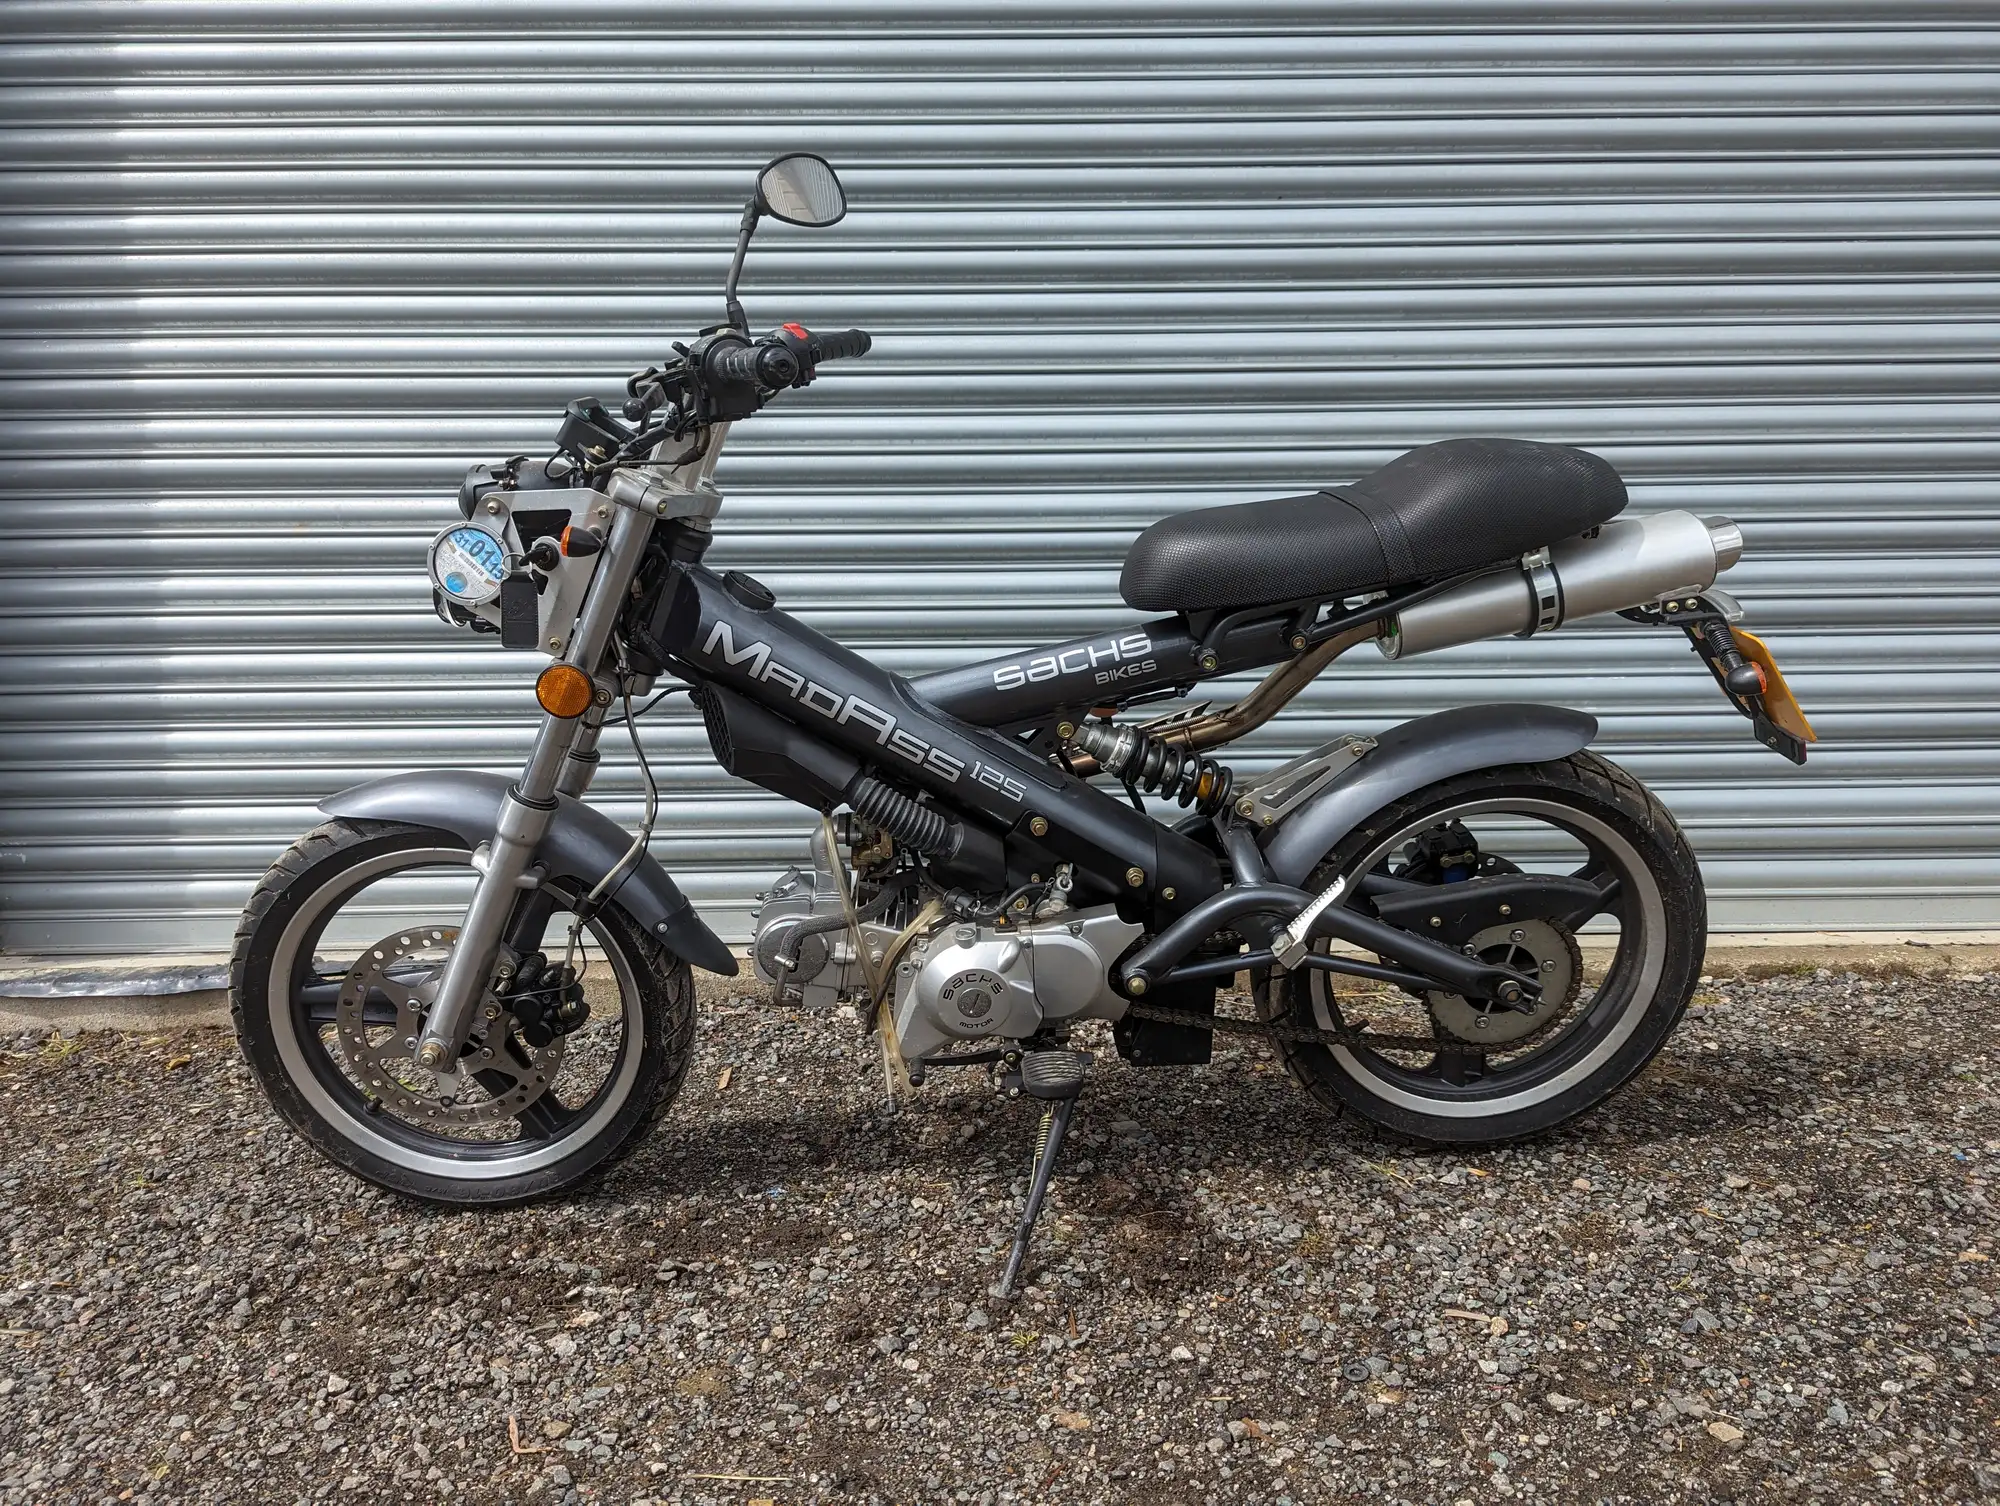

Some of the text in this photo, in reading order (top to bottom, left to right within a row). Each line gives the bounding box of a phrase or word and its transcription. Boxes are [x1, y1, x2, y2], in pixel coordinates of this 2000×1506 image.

[455, 532, 471, 549] 31
[468, 539, 496, 567] 01
[1094, 659, 1157, 685] BIKES
[969, 760, 1027, 803] 125
[959, 1018, 994, 1029] MOTOR
